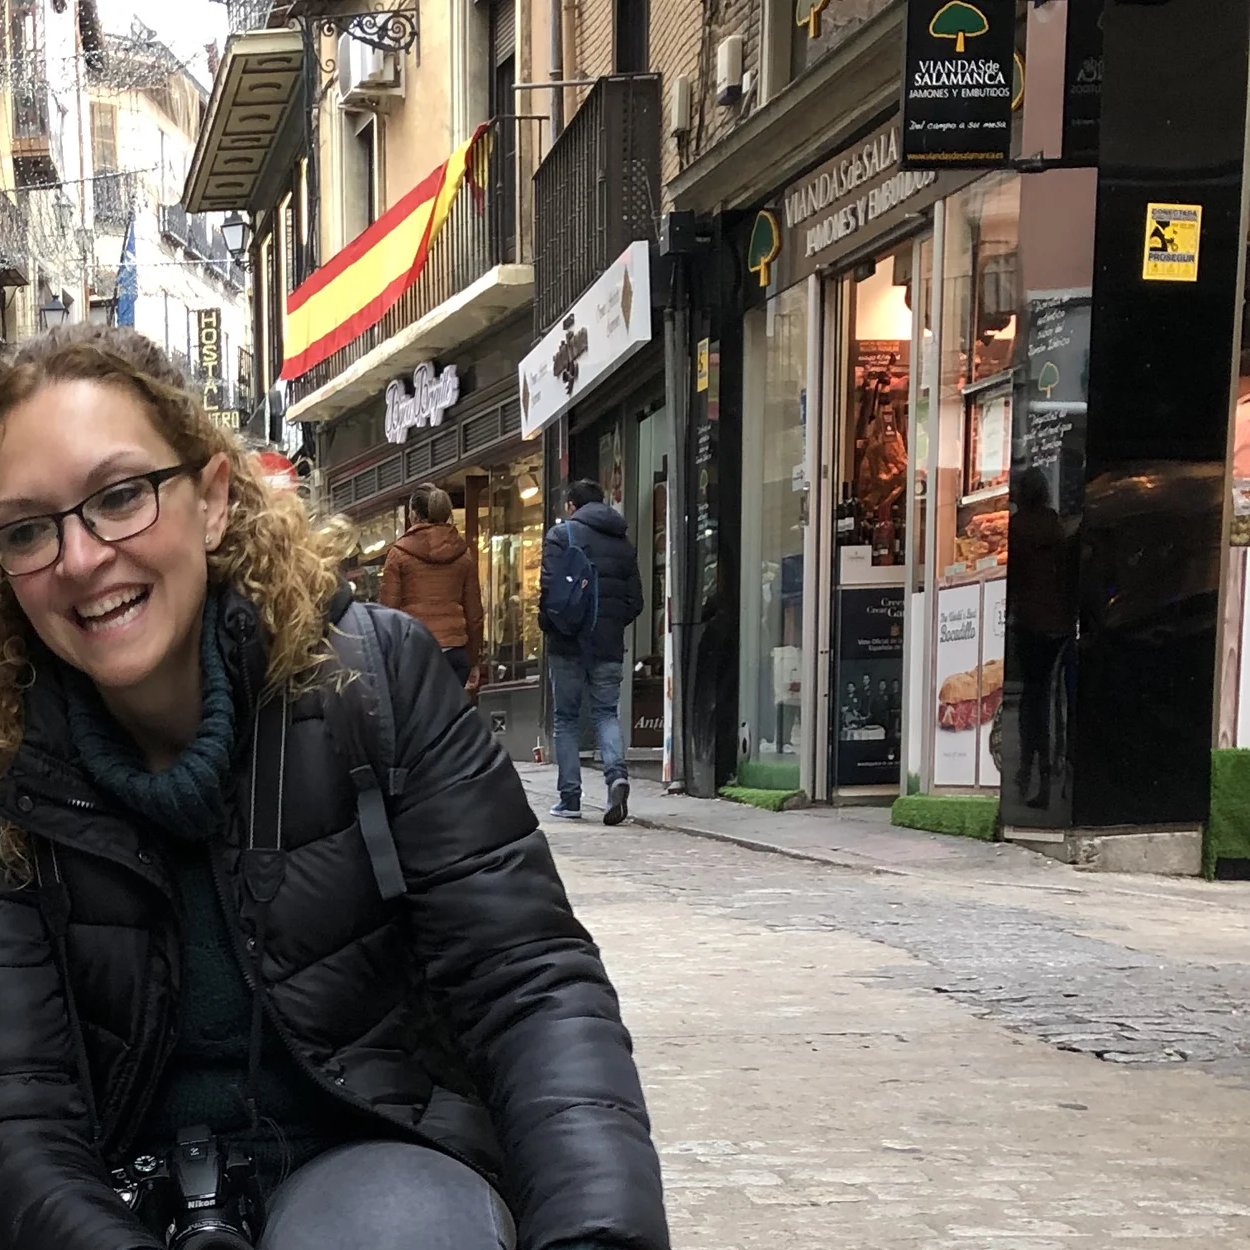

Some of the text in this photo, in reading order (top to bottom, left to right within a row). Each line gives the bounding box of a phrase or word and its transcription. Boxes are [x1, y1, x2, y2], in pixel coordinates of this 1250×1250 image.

[914, 72, 1006, 86] SALAMANCA
[909, 87, 1010, 98] JAMONES Y EMBUTIDOS
[909, 120, 925, 130] Del
[927, 122, 957, 131] campo
[805, 204, 856, 257] JAMONES
[856, 196, 867, 226] Y
[201, 311, 219, 411] HOSTAL
[208, 410, 240, 429] TRO
[940, 621, 976, 643] Bocadillo
[634, 716, 664, 730] Anti
[188, 1200, 216, 1209] Nikon
